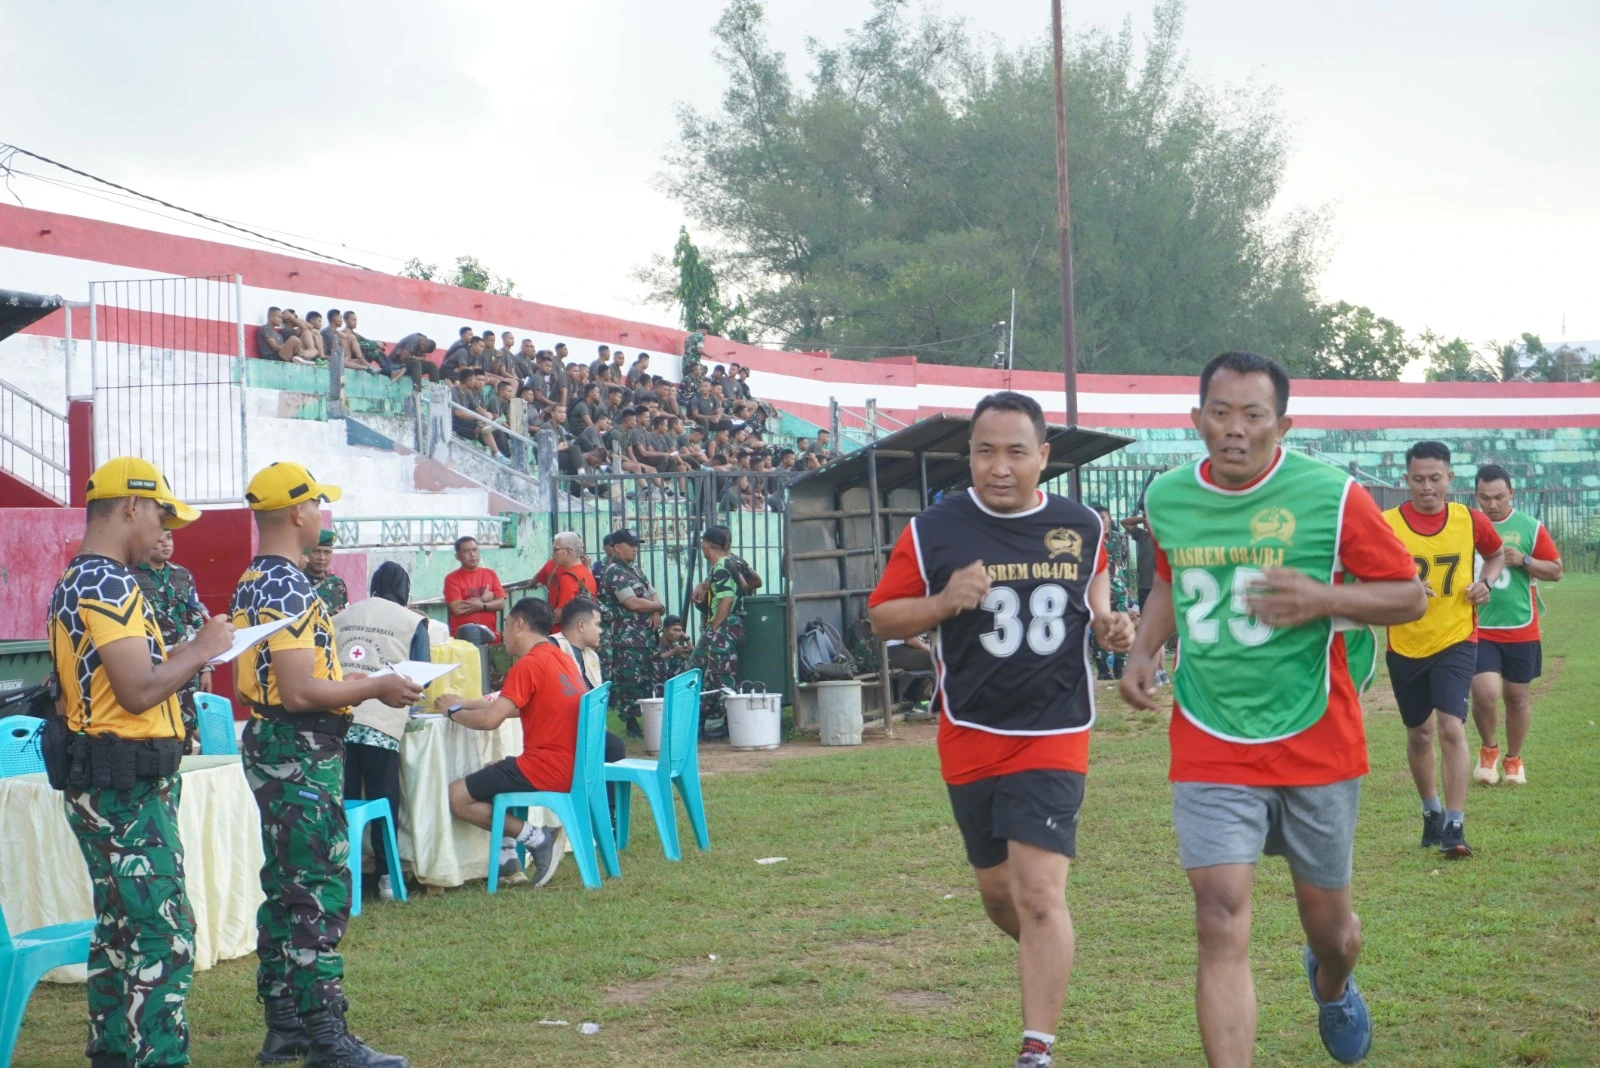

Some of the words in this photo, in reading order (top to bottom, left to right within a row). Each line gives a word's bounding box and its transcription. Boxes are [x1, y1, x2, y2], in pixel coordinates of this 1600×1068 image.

[1032, 562, 1078, 580] 084/BJ
[1229, 546, 1284, 567] 084/BJ
[979, 583, 1068, 657] 38
[1181, 566, 1275, 647] 25
